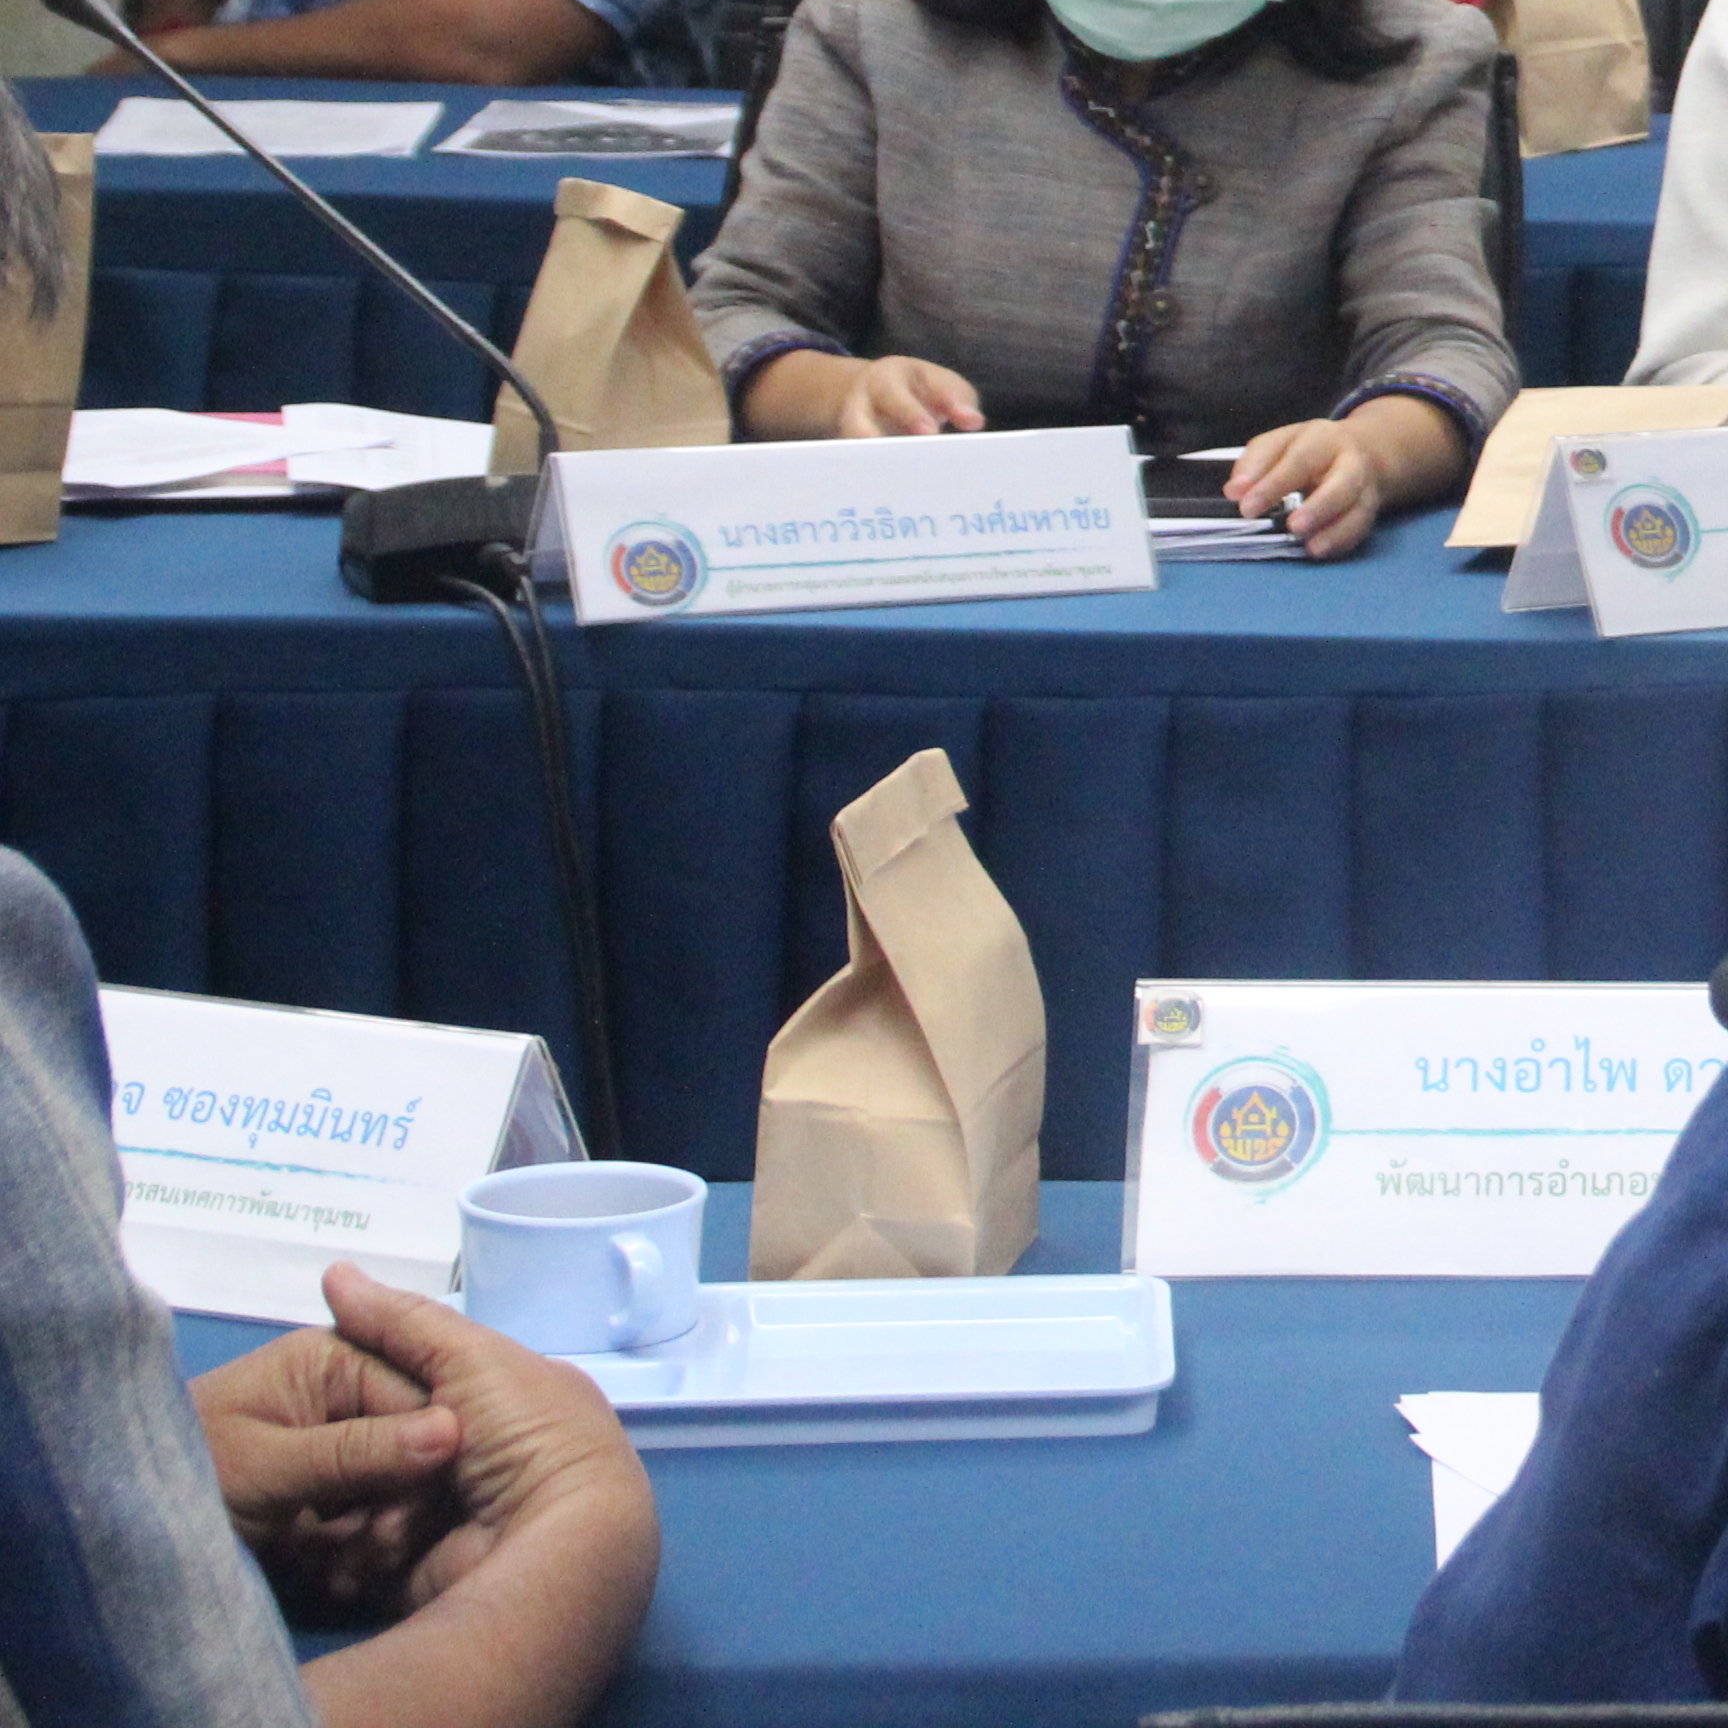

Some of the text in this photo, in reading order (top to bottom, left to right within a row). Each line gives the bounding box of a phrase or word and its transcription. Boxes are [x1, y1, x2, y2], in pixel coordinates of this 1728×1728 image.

[718, 495, 1111, 548] นางสาววีรธิดา วงศ์มหาชัย
[1414, 1034, 1639, 1094] นางอำไพ
[1375, 1158, 1663, 1198] พัฒนาการอำเภอ
[124, 1179, 372, 1233] ารสนเทศการพัฒนาชุมชน
